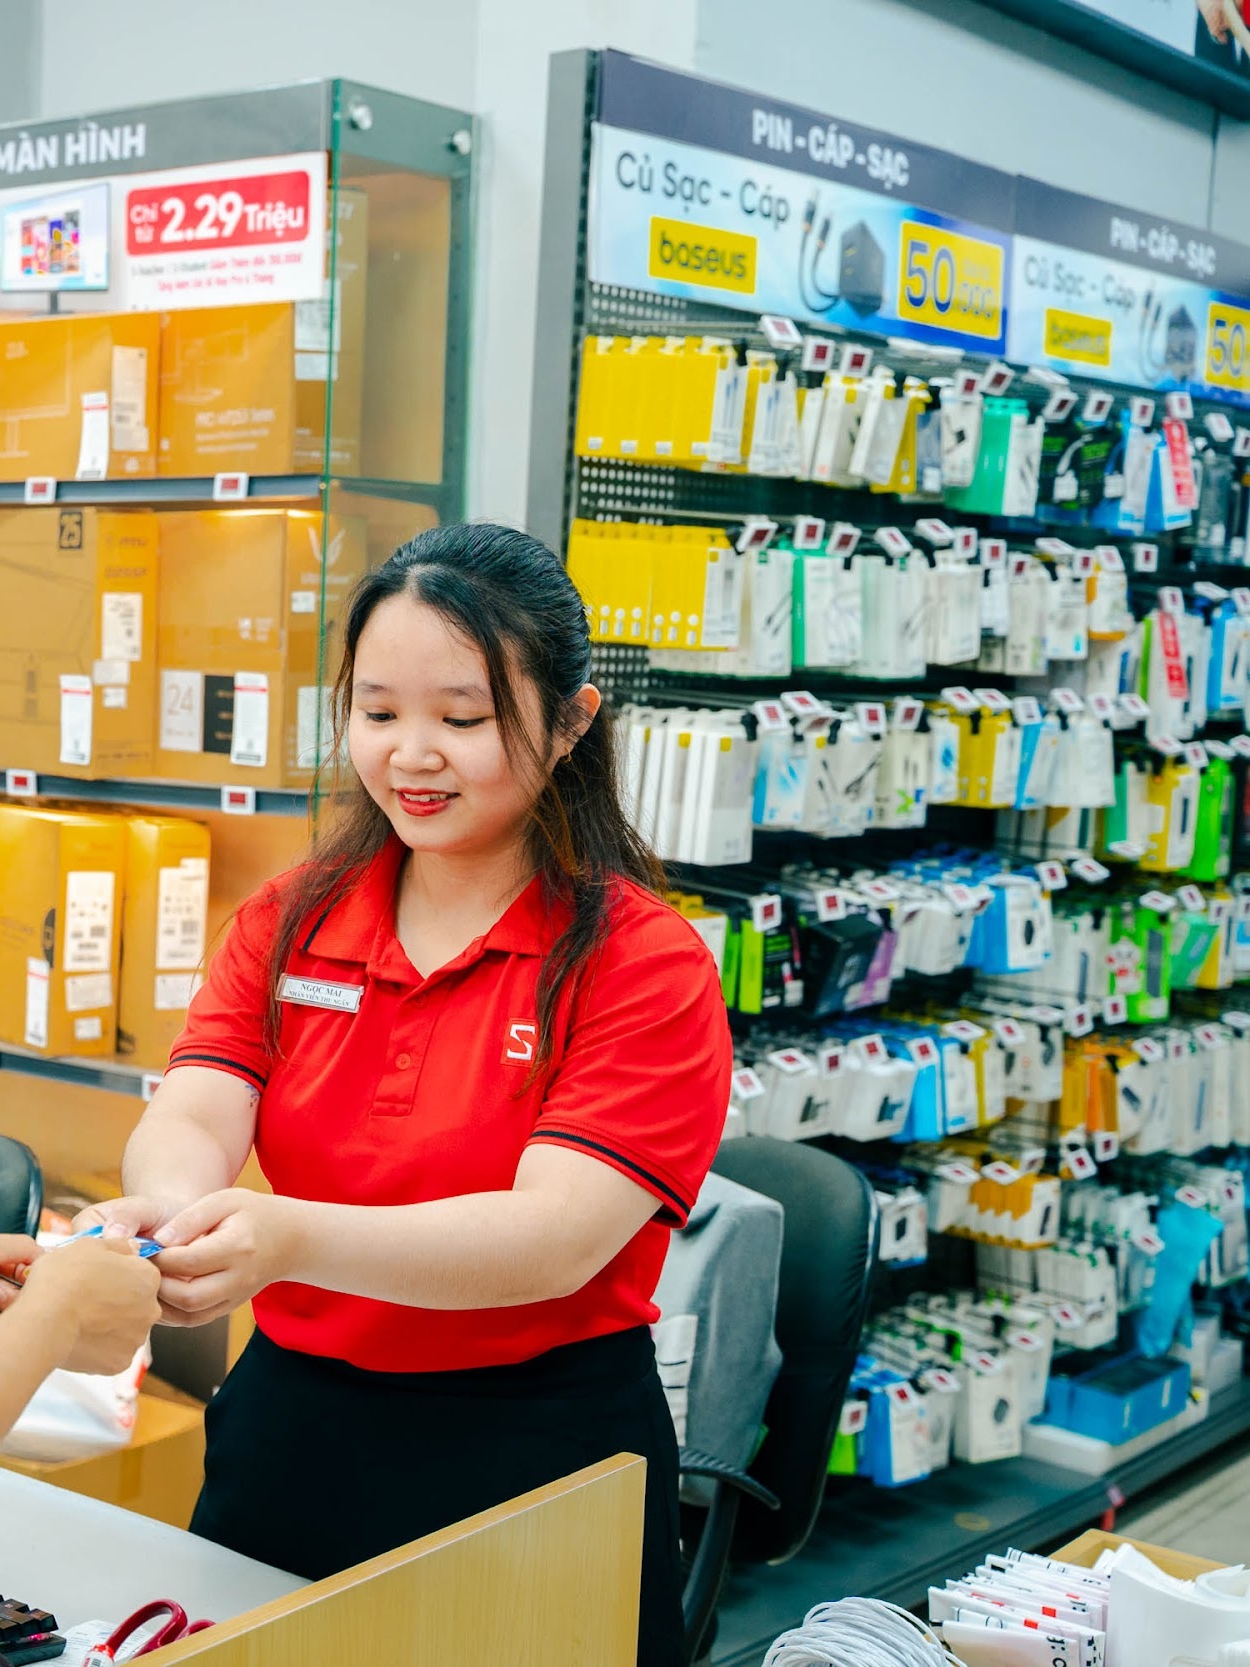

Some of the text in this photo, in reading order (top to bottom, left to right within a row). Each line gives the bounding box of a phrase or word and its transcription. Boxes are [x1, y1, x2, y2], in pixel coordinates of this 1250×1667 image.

[64, 121, 146, 167] HÌNH
[160, 191, 244, 244] 2.29
[244, 200, 305, 237] Triệu
[616, 152, 653, 192] Củ
[662, 161, 711, 213] Sạc
[739, 179, 790, 231] Cáp
[657, 229, 747, 280] baseus
[1209, 317, 1246, 378] 50
[301, 983, 342, 998] NGỌC MAI
